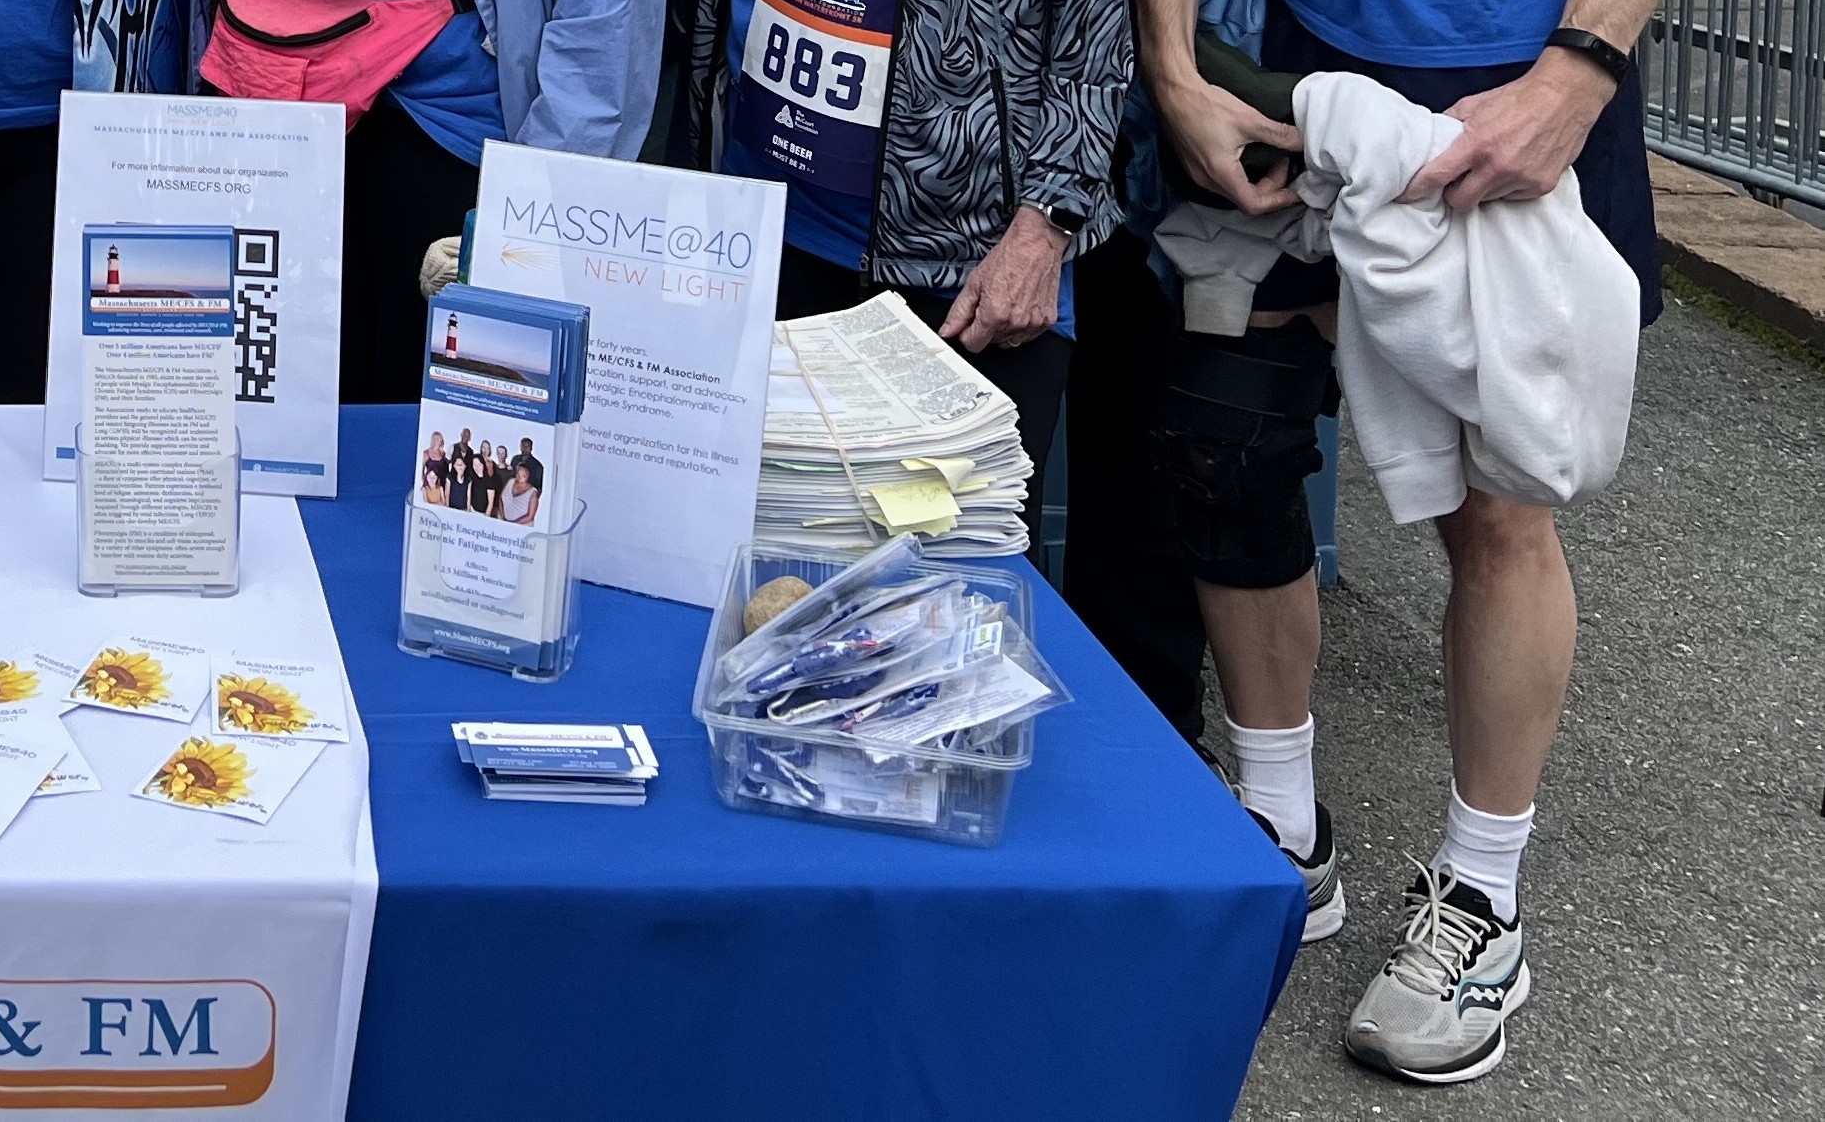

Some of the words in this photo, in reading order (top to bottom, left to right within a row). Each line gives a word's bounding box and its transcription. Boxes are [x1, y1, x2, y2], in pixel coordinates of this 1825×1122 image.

[762, 22, 867, 111] 883
[248, 132, 309, 142] ASSOCIATION
[772, 134, 789, 151] ONE
[789, 142, 813, 160] BEER
[111, 161, 125, 170] For
[127, 163, 148, 171] more
[198, 164, 221, 175] about
[772, 150, 789, 163] MUST
[503, 196, 753, 270] MASSME@40
[584, 257, 649, 287] NEW
[661, 275, 746, 303] LIGHT
[596, 338, 618, 353] forty
[598, 353, 635, 368] ME/CFS
[637, 361, 643, 370] &
[646, 362, 661, 373] FM
[663, 366, 721, 384] Association
[585, 392, 620, 409] Fatigue
[587, 367, 626, 381] ucation,
[671, 382, 692, 394] and
[694, 386, 748, 405] advocacy
[588, 380, 626, 396] Myalgic
[607, 445, 641, 459] stature
[643, 452, 664, 465] and
[665, 456, 722, 477] reputation.
[613, 432, 675, 452] organization
[676, 443, 690, 455] for
[692, 447, 709, 459] this
[710, 450, 740, 466] illness
[457, 537, 490, 553] Fatigue
[490, 546, 535, 565] Syndrome
[80, 996, 220, 1057] FM
